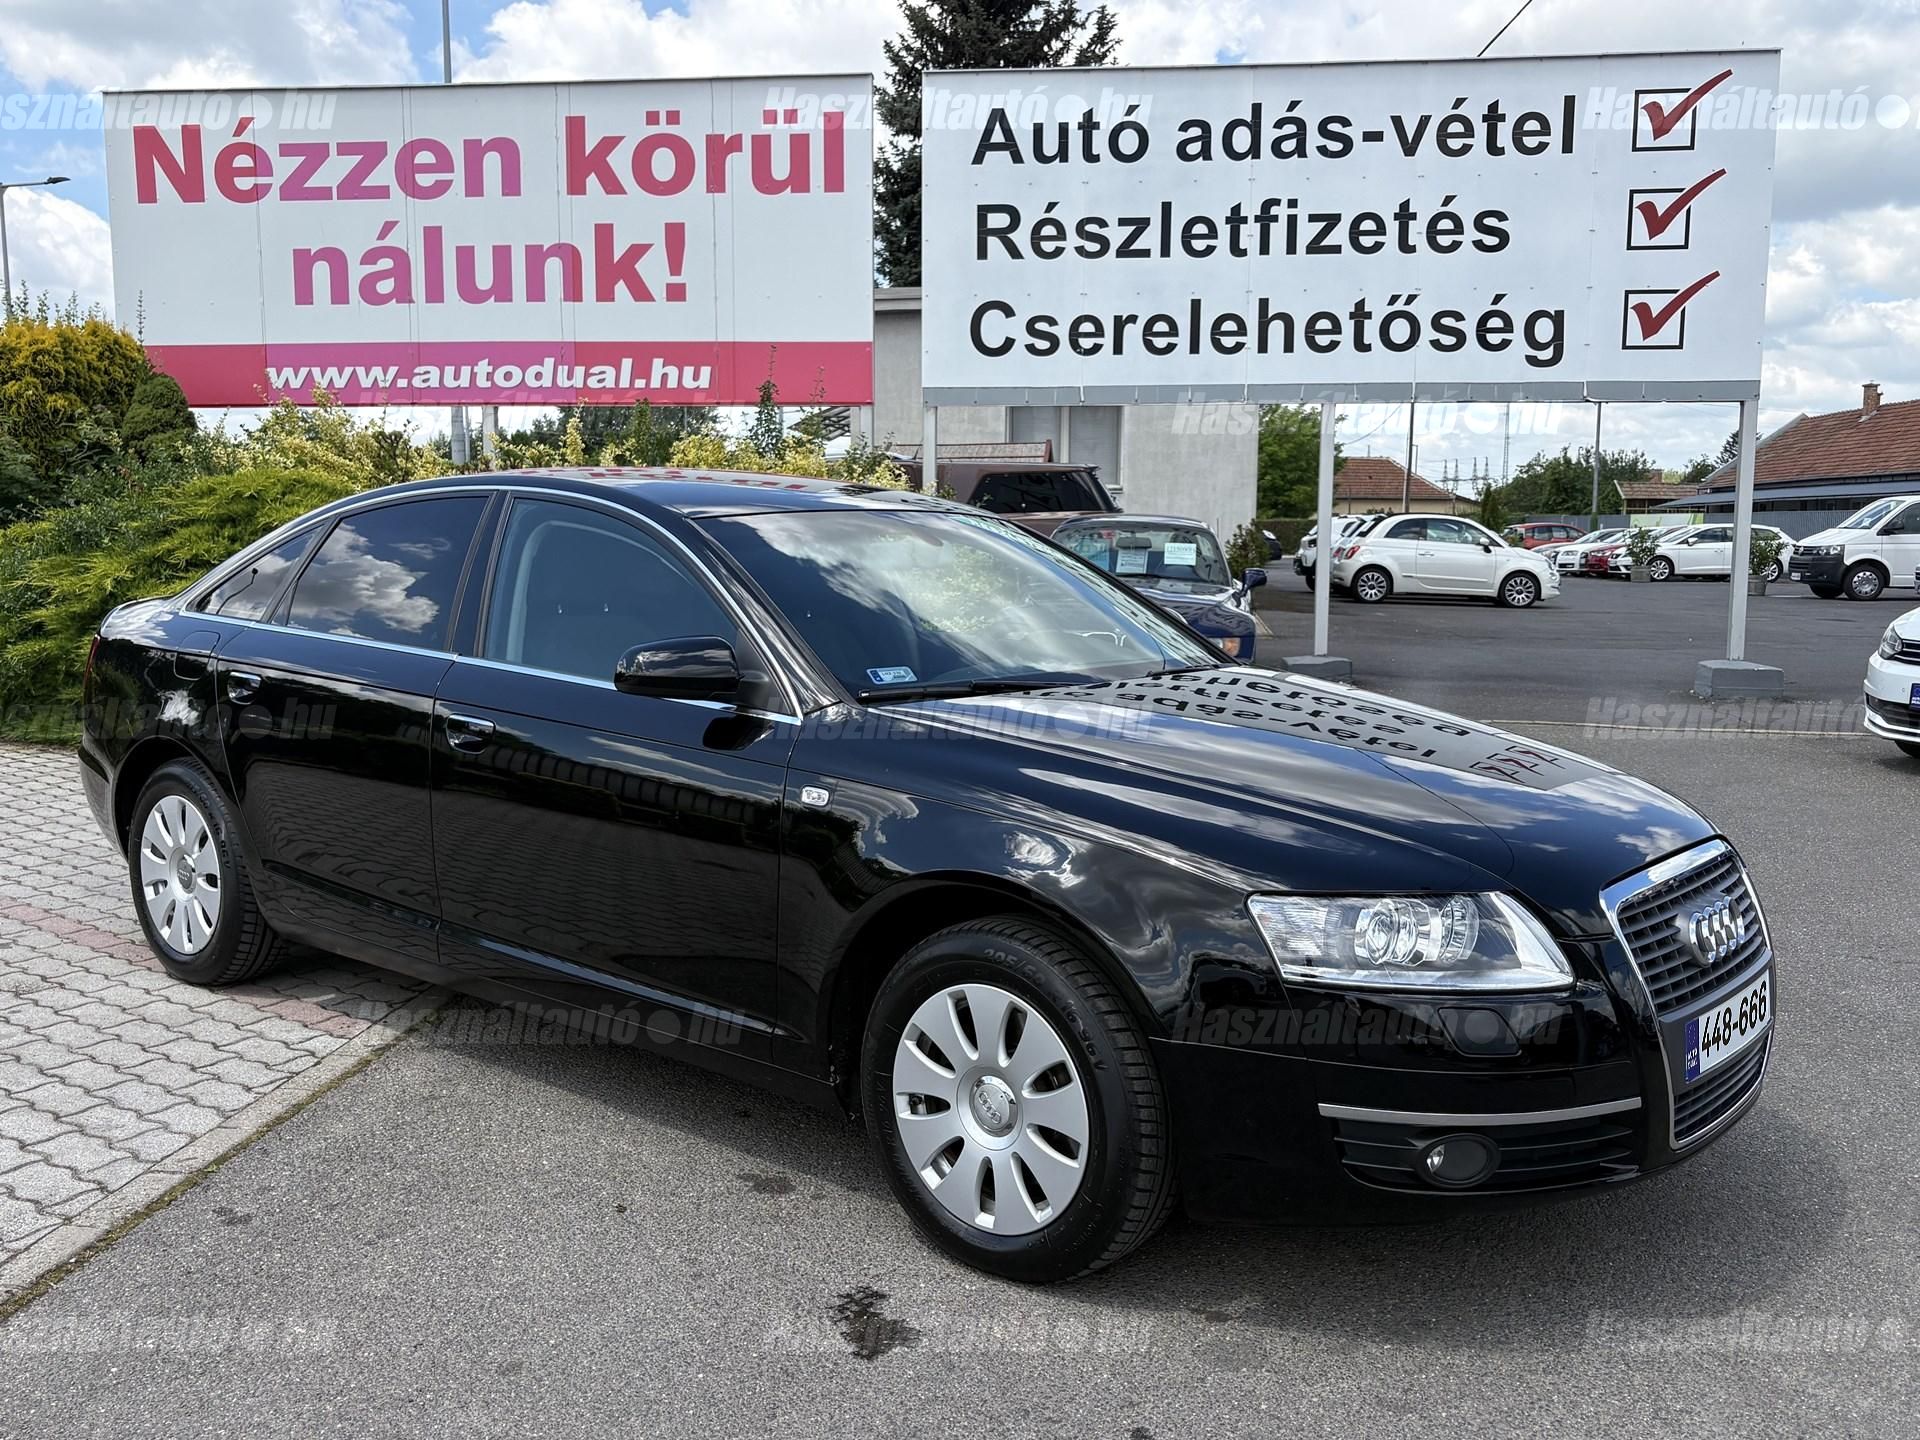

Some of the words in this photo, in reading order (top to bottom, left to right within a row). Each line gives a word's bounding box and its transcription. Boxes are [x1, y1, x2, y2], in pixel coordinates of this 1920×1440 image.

[133, 117, 521, 204] Nézzen
[566, 109, 845, 196] körül
[971, 105, 1149, 165] Autó
[1176, 95, 1576, 162] adás-vétel
[293, 222, 686, 305] nálunk!
[976, 194, 1510, 261] Részletfizetés
[970, 293, 1565, 368] Cserelehetőség
[267, 357, 712, 390] www.autodual.hu
[1701, 980, 1767, 1058] 448-666
